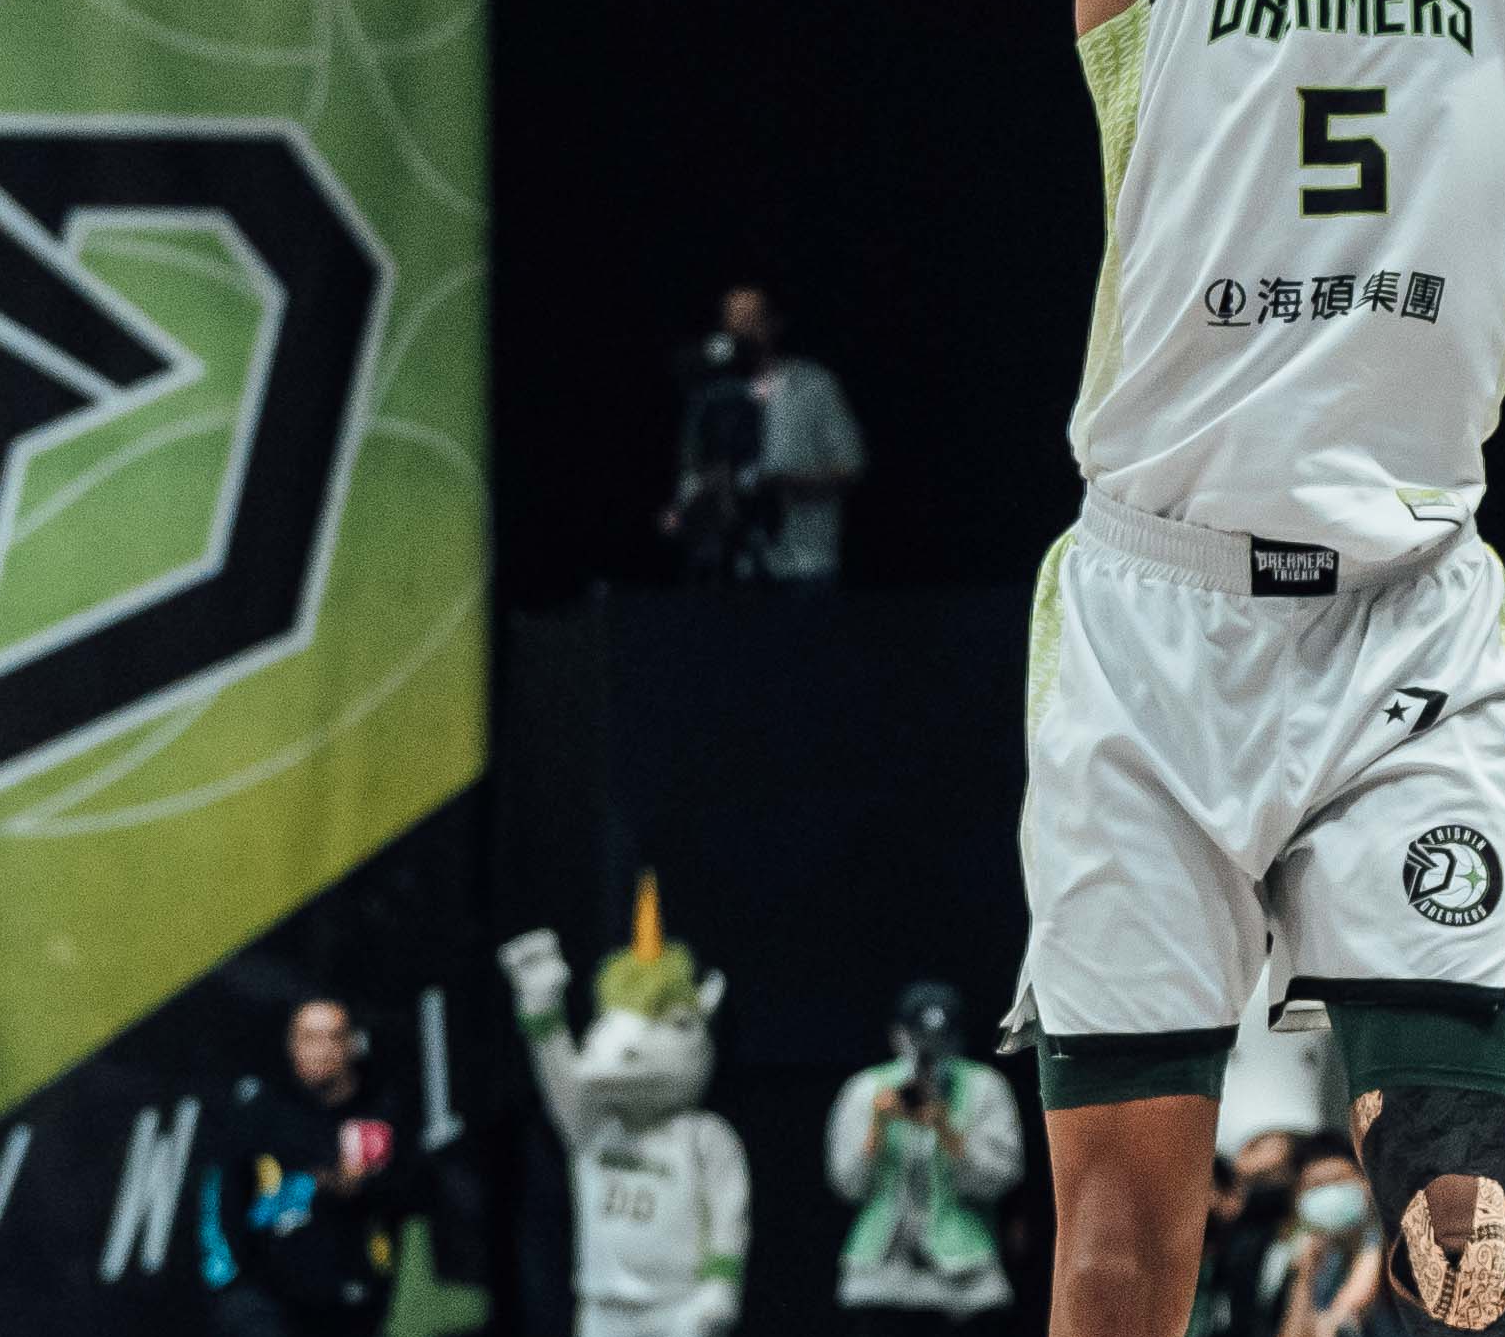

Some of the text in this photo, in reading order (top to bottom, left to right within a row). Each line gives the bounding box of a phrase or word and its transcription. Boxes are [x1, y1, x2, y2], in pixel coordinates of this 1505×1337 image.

[1298, 87, 1389, 218] 5
[1257, 269, 1446, 325] 海碩集團
[1254, 549, 1335, 572] DREAMERS
